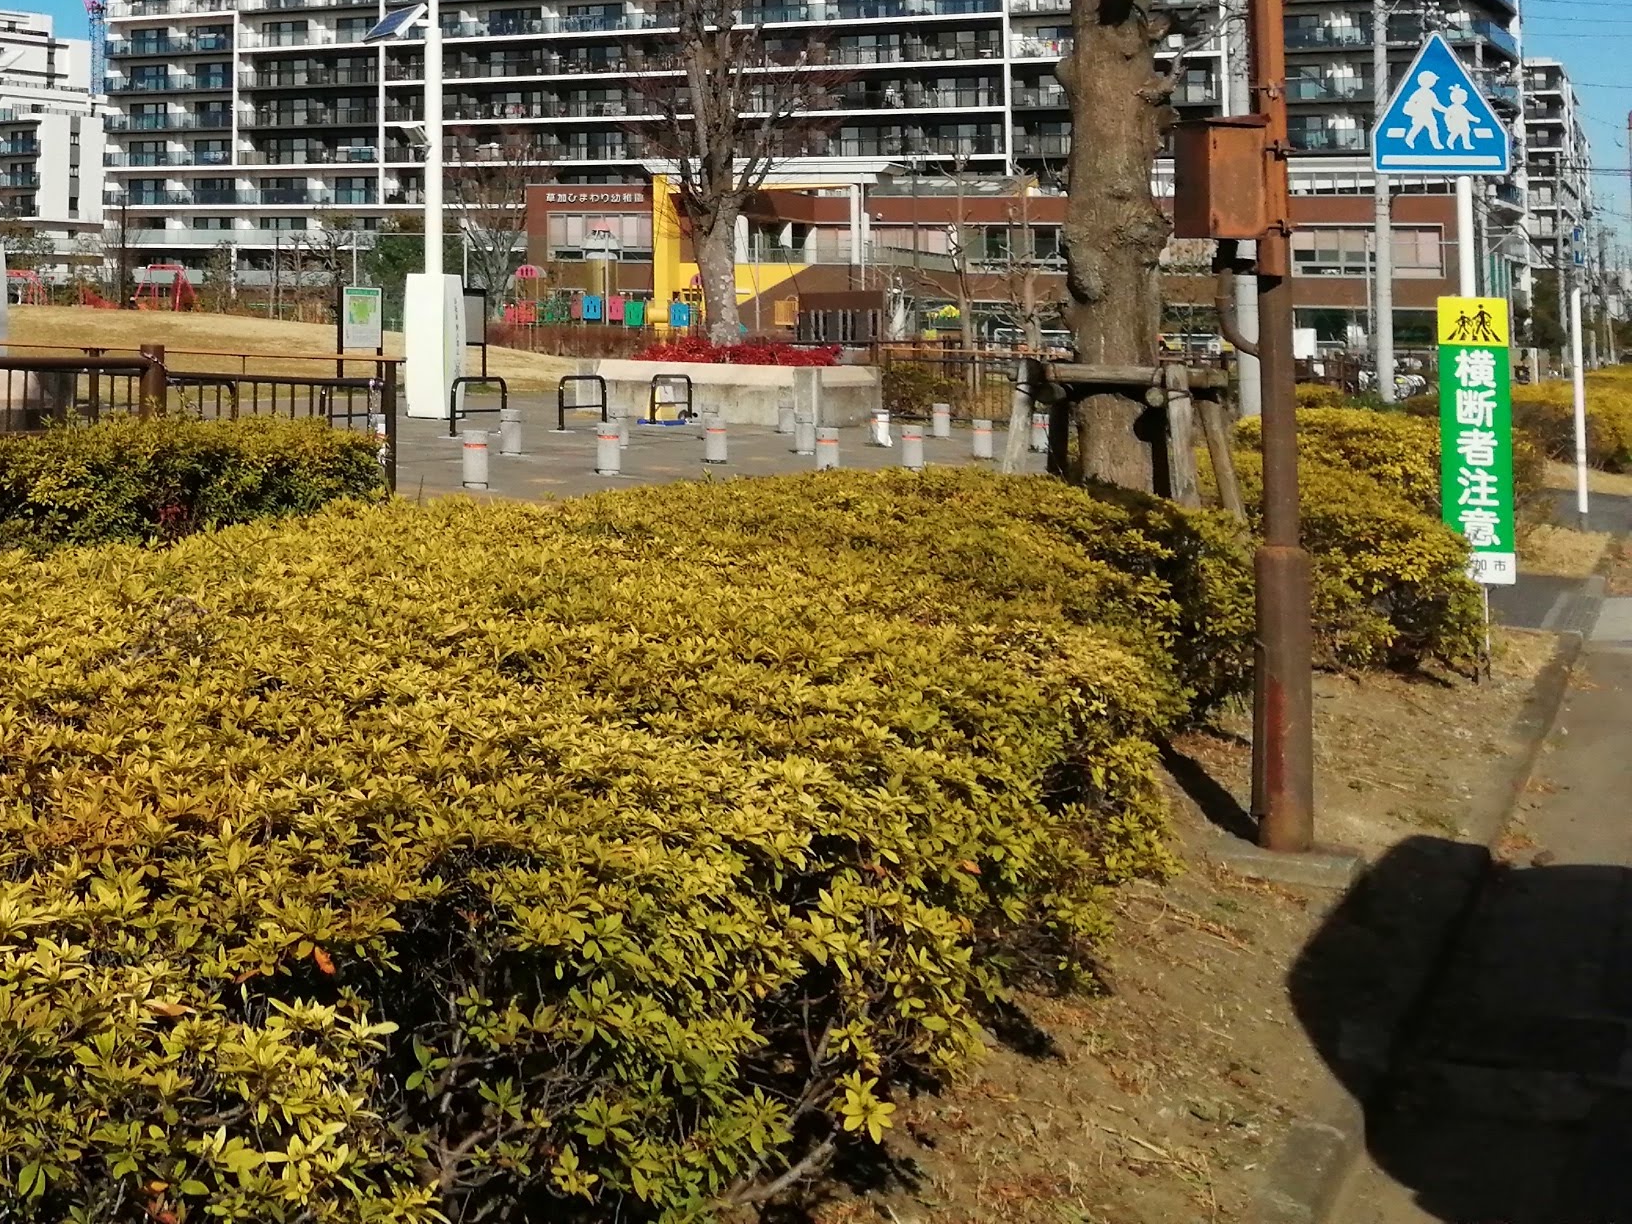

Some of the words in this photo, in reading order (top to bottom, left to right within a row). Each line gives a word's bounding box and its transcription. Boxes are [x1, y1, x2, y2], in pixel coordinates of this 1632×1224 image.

[546, 193, 644, 203] 草加ひまわり幼稚園
[1454, 349, 1501, 547] 横断者注意
